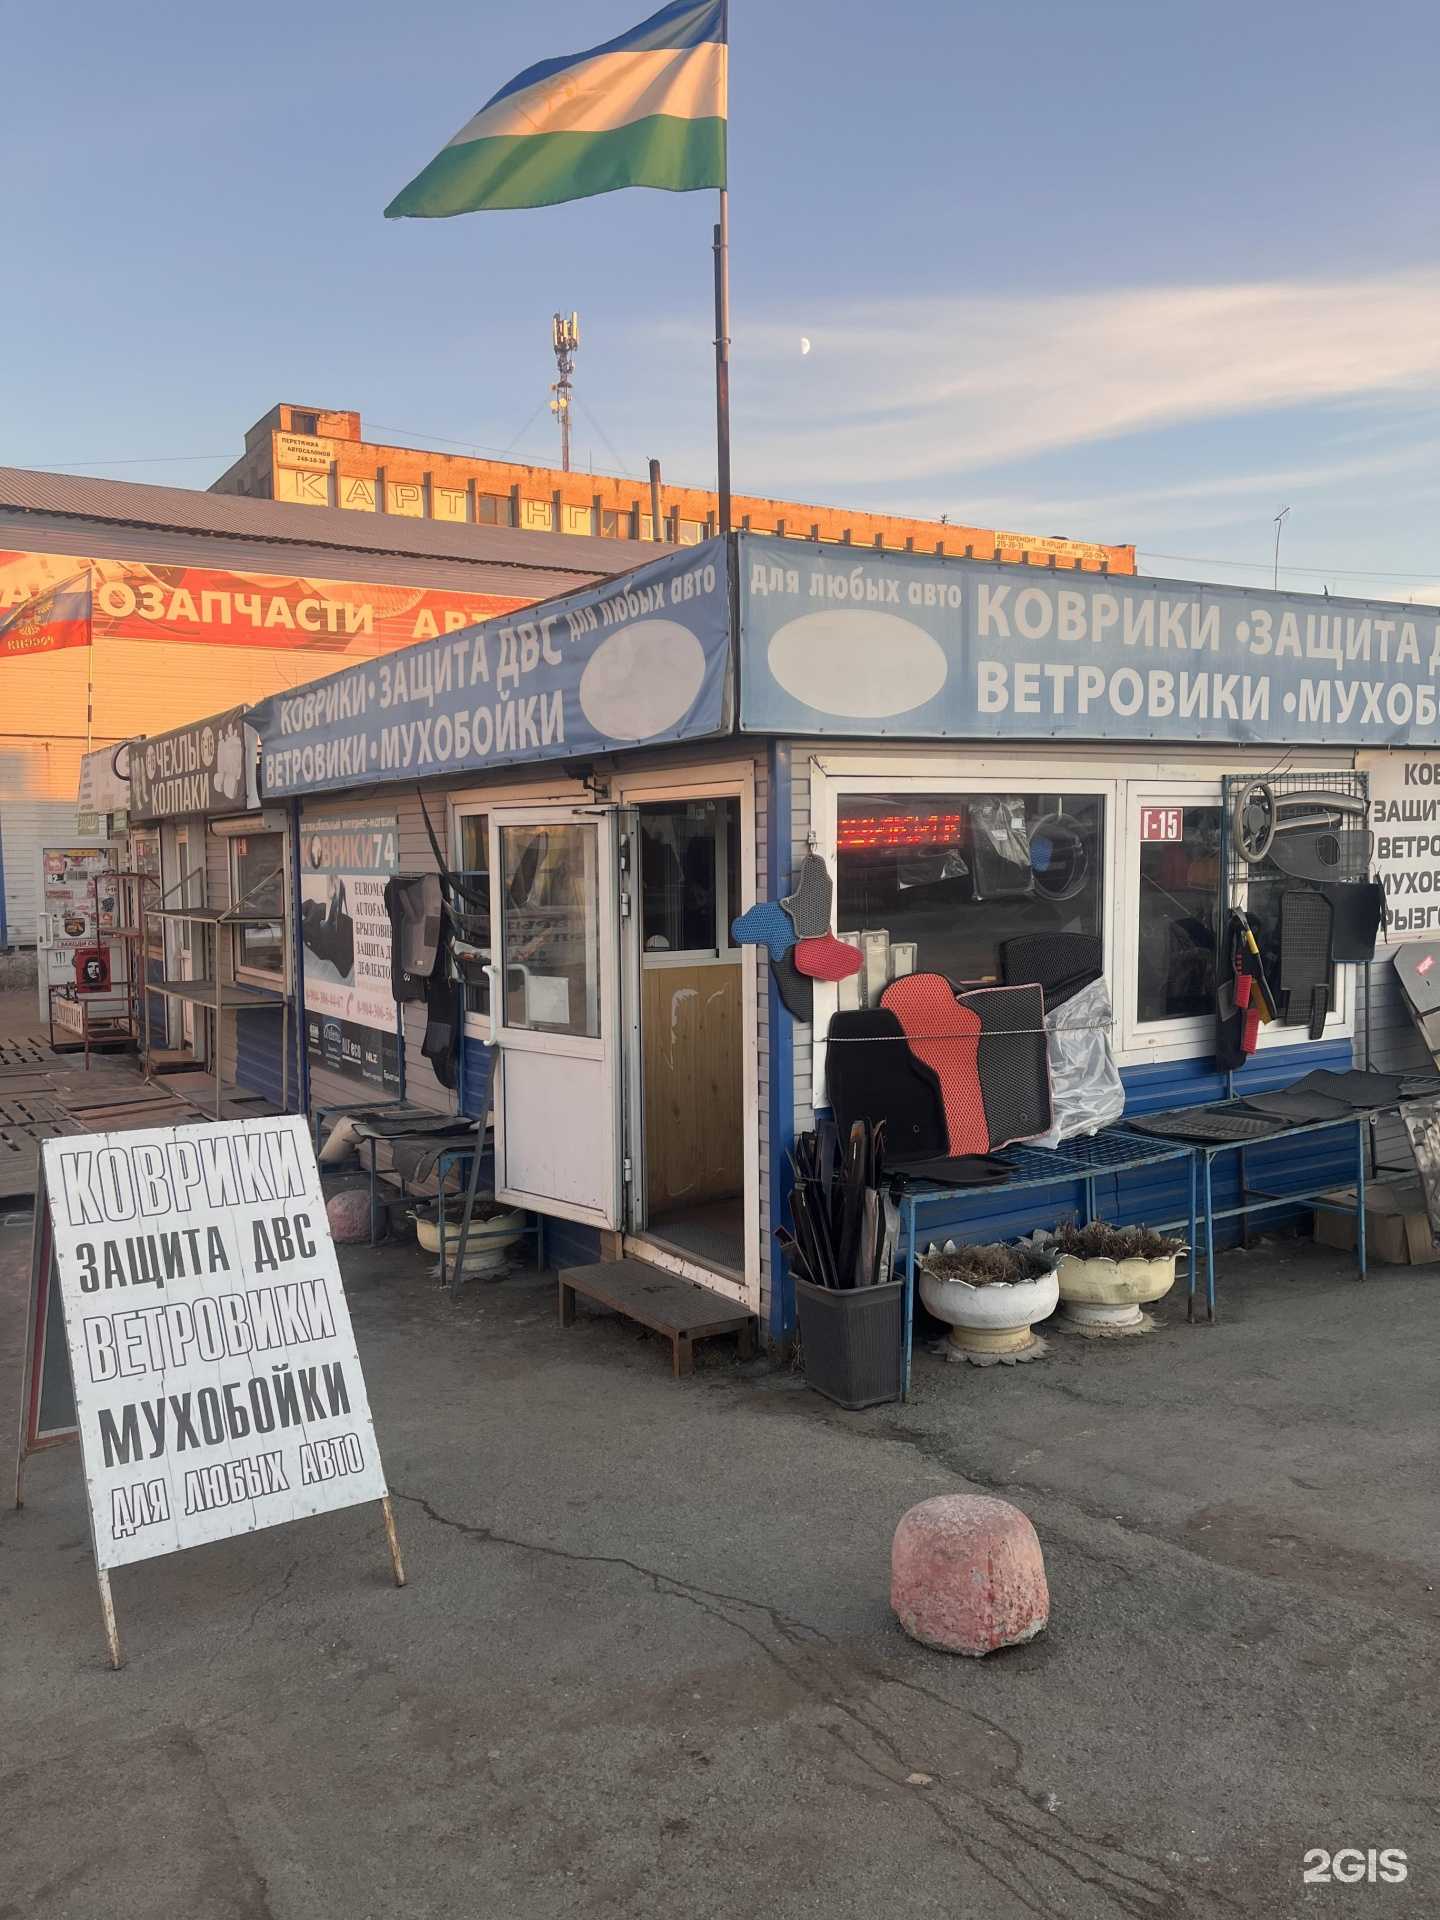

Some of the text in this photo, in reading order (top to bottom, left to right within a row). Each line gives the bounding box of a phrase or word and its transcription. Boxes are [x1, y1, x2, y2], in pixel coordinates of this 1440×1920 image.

[411, 608, 492, 638] АВ
[564, 564, 716, 642] для любых авто
[750, 564, 962, 609] для любых авто
[977, 583, 1220, 651] КОВРИКИ
[1248, 609, 1421, 671] ЗАЩИТА
[279, 614, 563, 736] КОВРИКИ ЗАЩИТА ДВС
[977, 660, 1437, 726] ВЕТРОВИКИ МУХОБ
[155, 730, 201, 779] ЧЕХЛЫ
[265, 689, 566, 789] ВЕТРОВИКИ МУХОБОЙКИ
[152, 773, 210, 816] КОЛПАКИ
[1143, 810, 1179, 840] Г-15
[1374, 800, 1440, 823] ЗАЩИ
[356, 941, 384, 960] ЗАЩИТА
[60, 1129, 306, 1226] КОВРИКИ
[75, 1213, 317, 1294] ЗАЩИТА ДВС
[83, 1278, 337, 1384] ВЕТРОВИКИ
[97, 1361, 353, 1468] МУХОБОЙКИ
[111, 1432, 365, 1539] ДЛЯ ЛЮБЫХ АВТО
